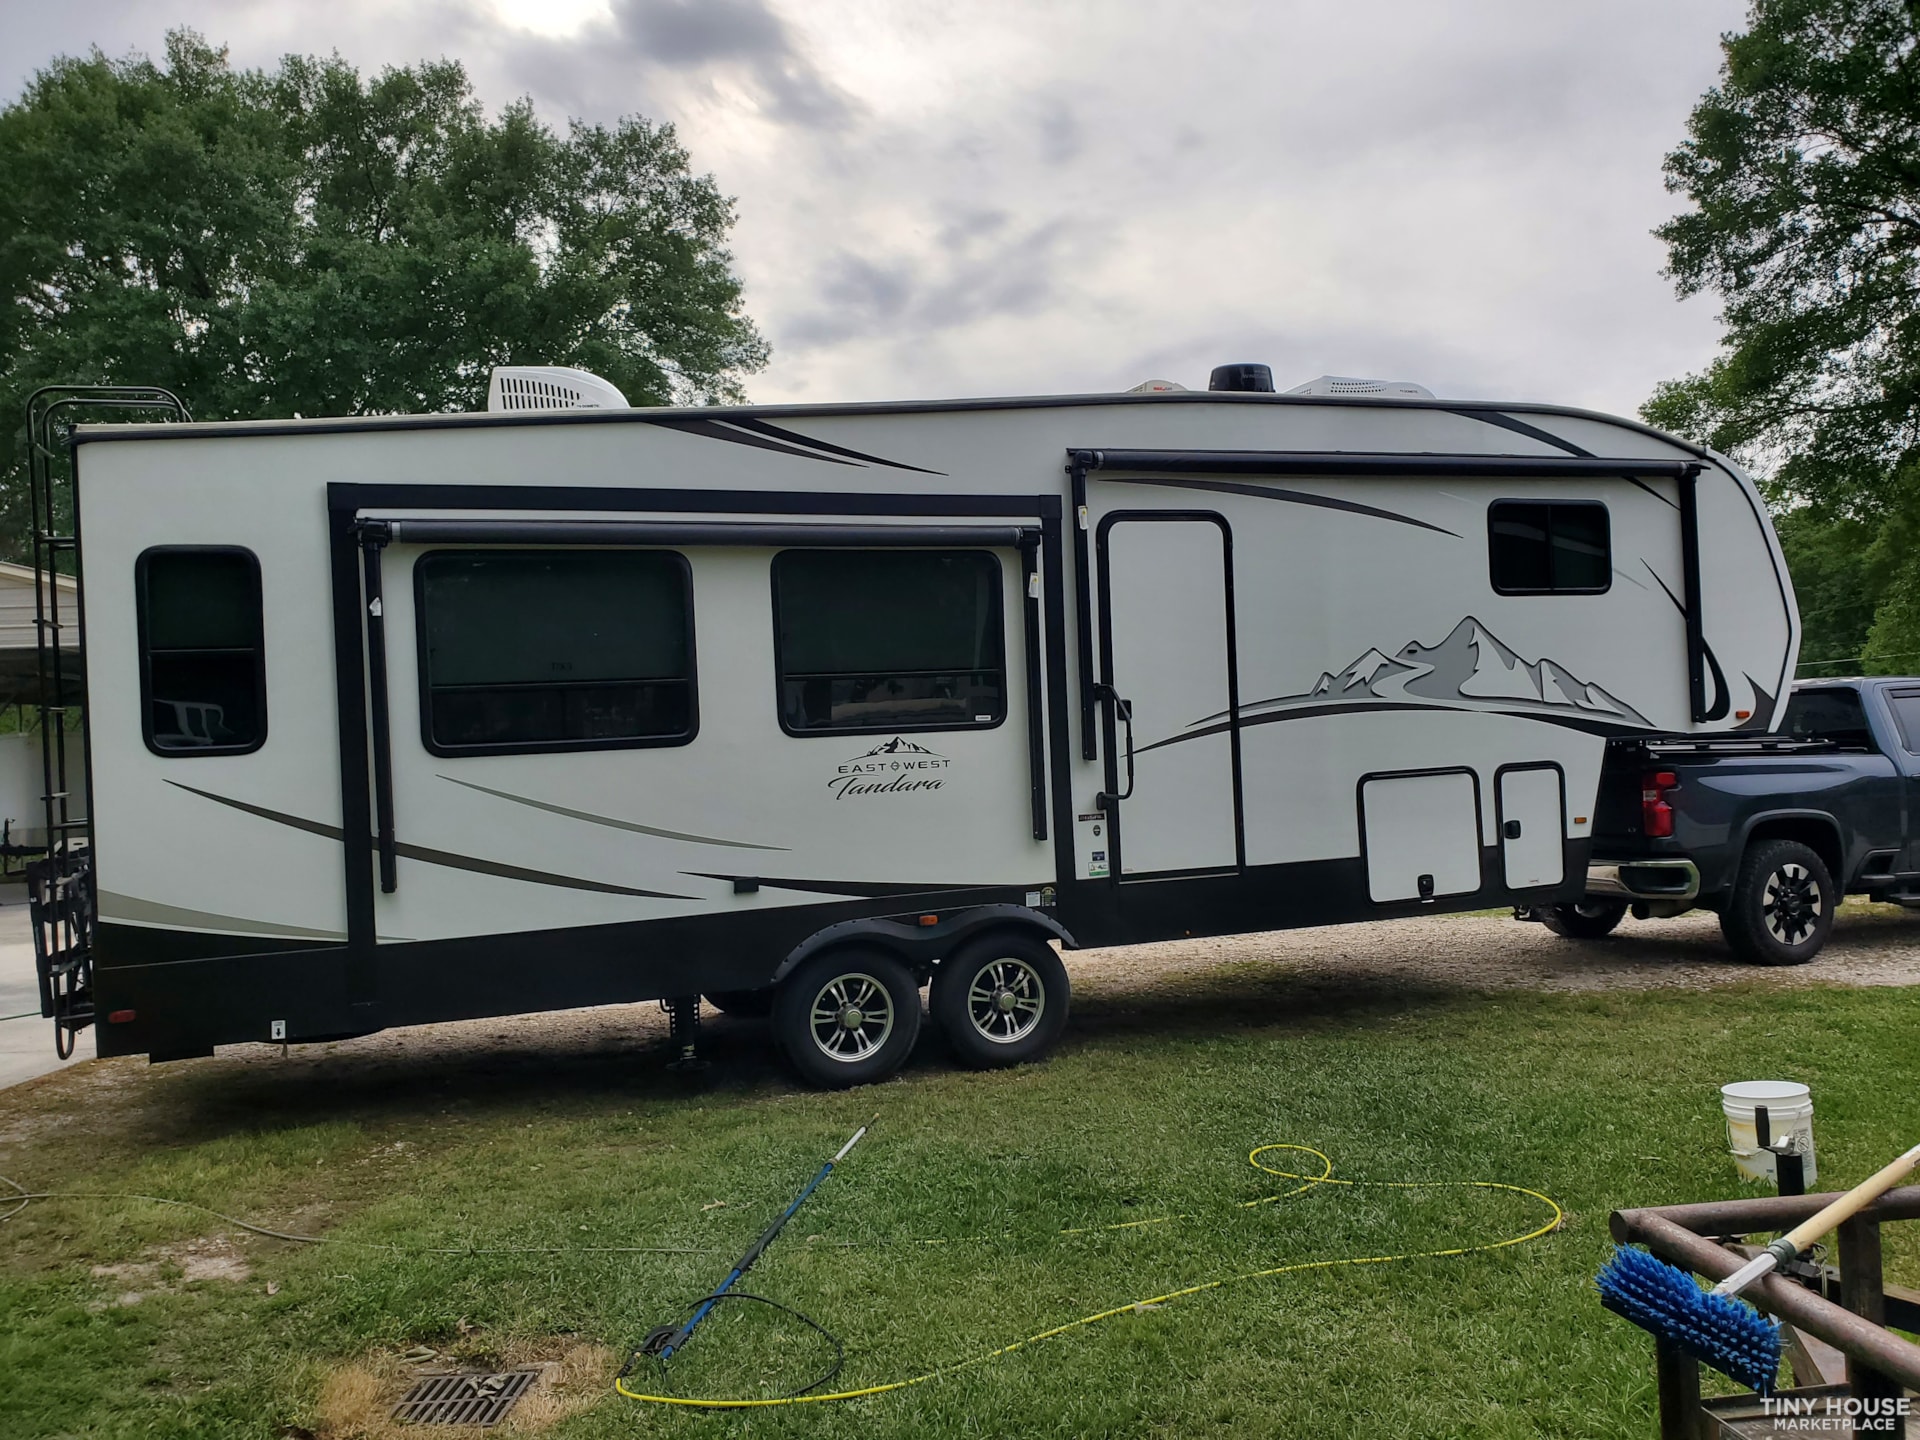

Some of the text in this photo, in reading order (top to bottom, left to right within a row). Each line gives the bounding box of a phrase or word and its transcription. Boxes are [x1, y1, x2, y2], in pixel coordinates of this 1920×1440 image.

[838, 759, 951, 774] EAST WEST
[827, 773, 946, 801] Tandara
